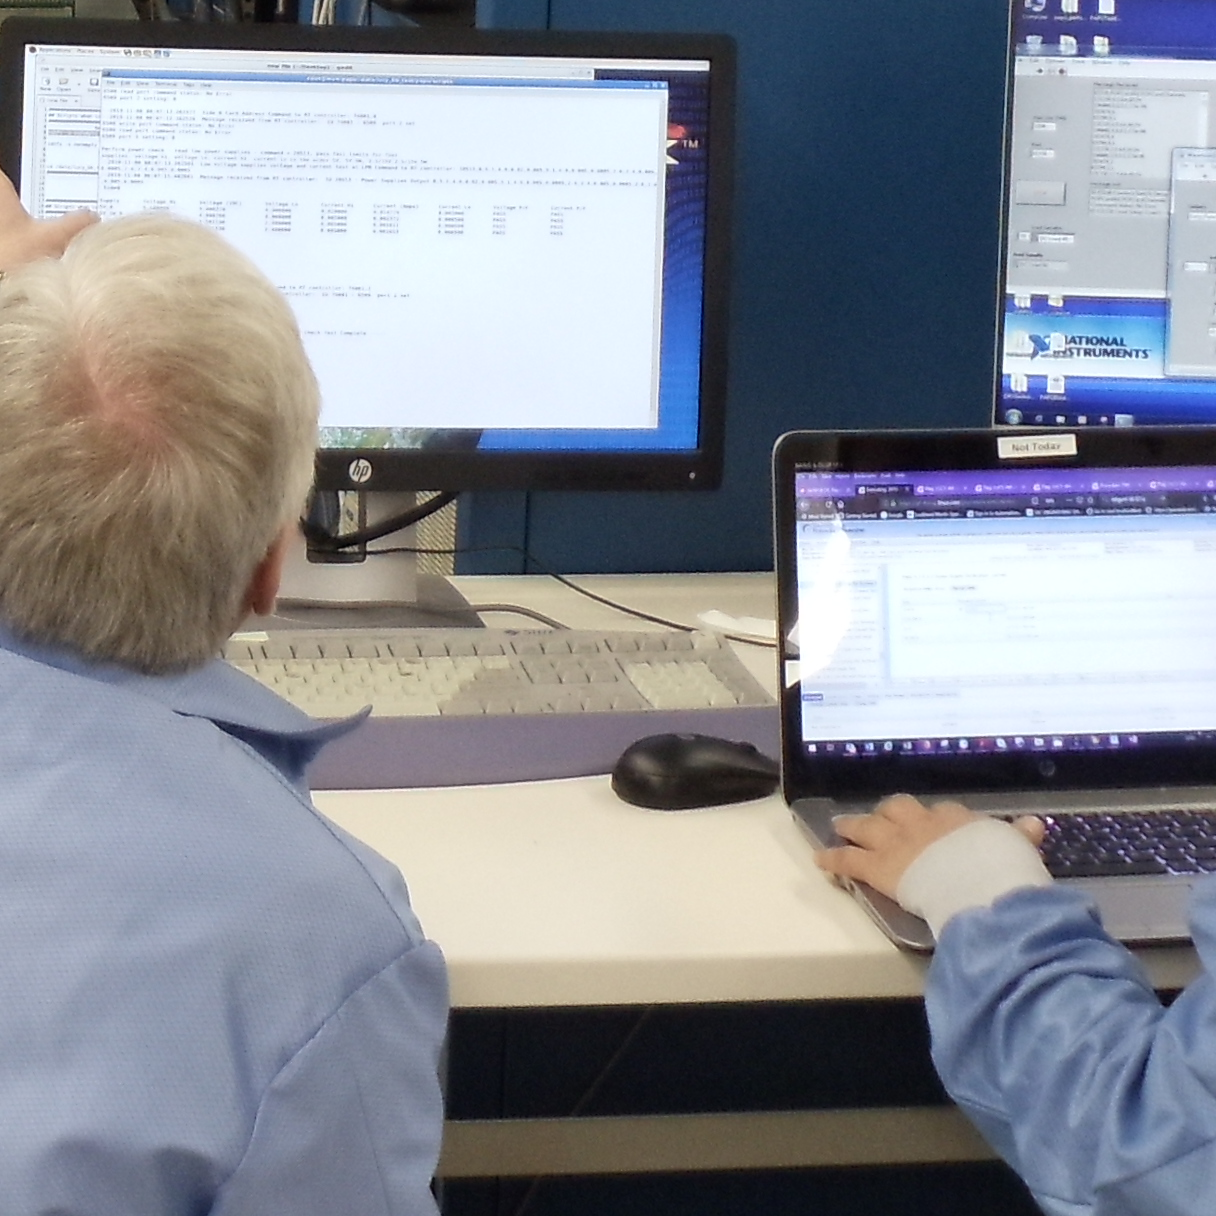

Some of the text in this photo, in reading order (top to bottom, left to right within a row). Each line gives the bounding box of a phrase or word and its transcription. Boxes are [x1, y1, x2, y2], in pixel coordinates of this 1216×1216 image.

[1011, 442, 1061, 452] Not Today
[351, 458, 371, 483] hp
